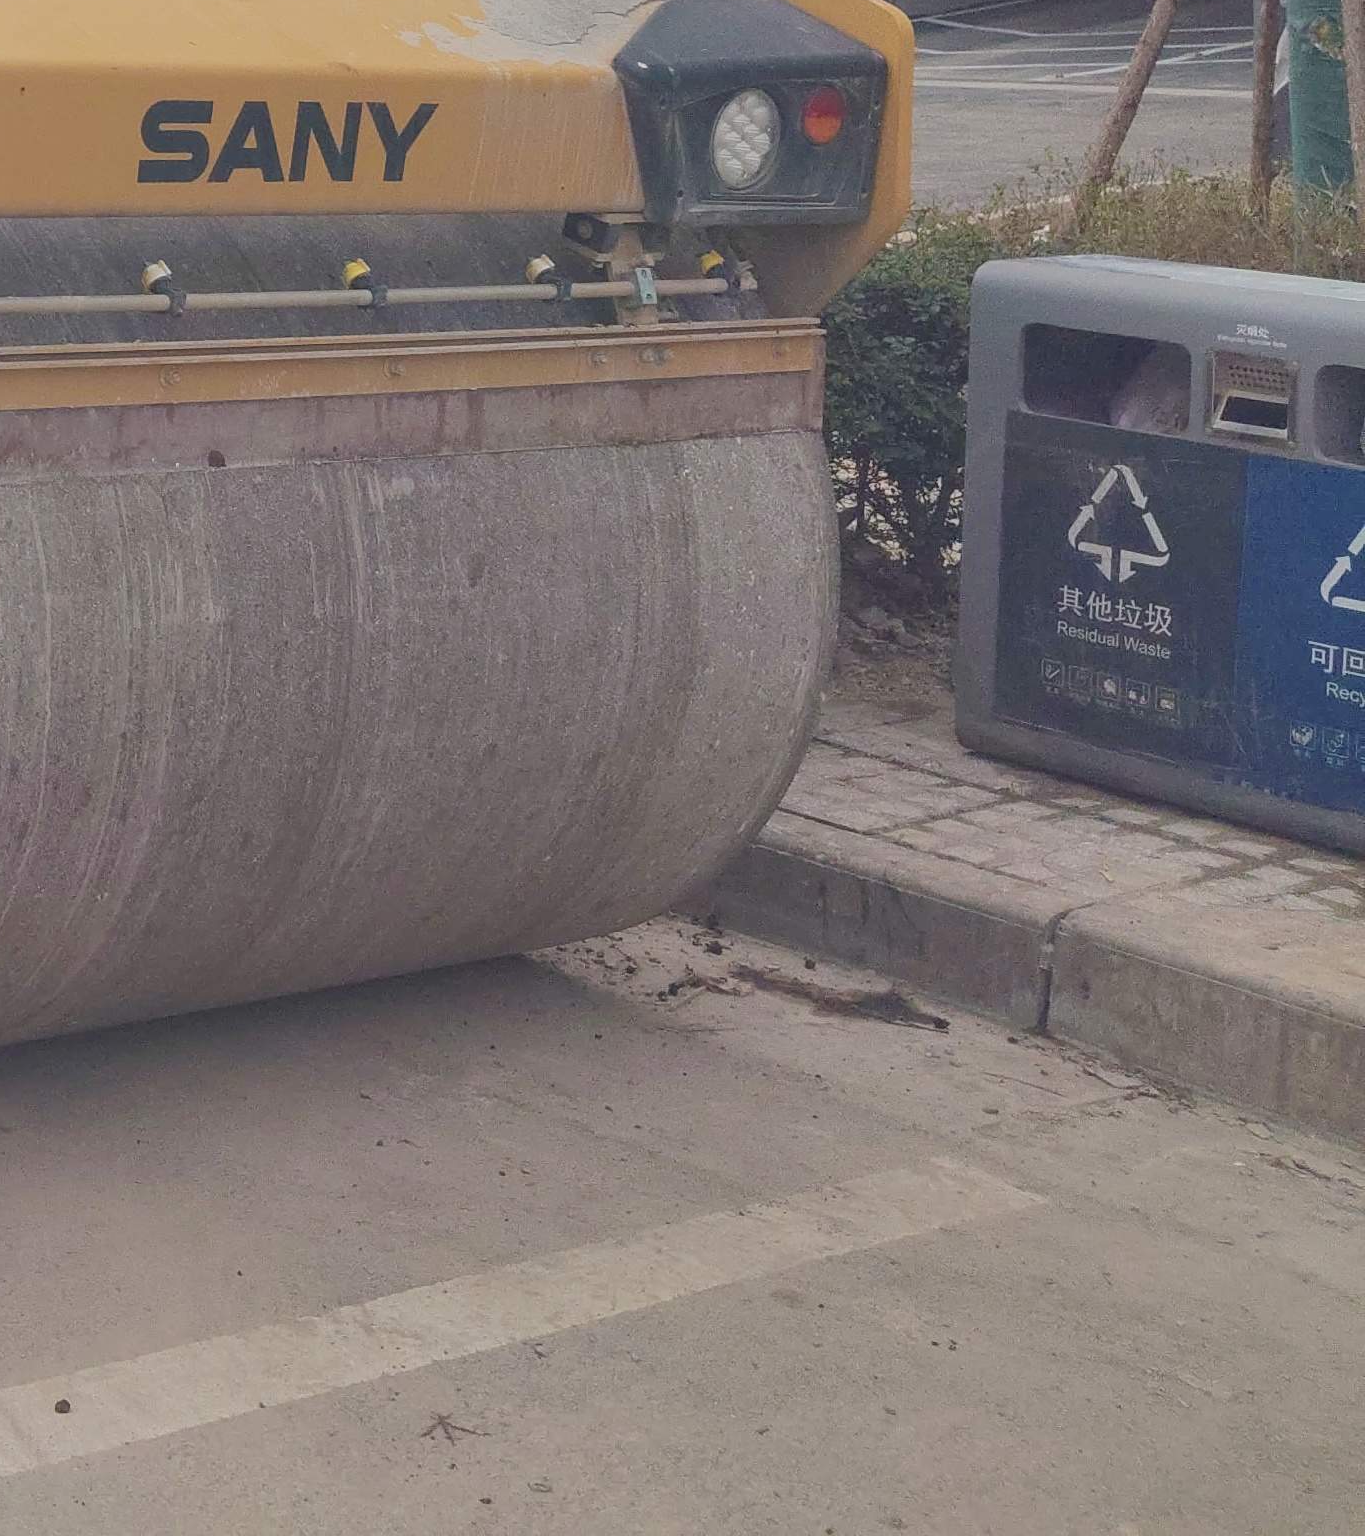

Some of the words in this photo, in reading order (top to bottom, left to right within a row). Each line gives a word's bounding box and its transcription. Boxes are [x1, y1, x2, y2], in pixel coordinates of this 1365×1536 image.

[138, 100, 439, 183] SANY
[1057, 584, 1173, 637] 其他垃圾
[1057, 620, 1119, 647] Residual
[1123, 636, 1172, 659] Waste
